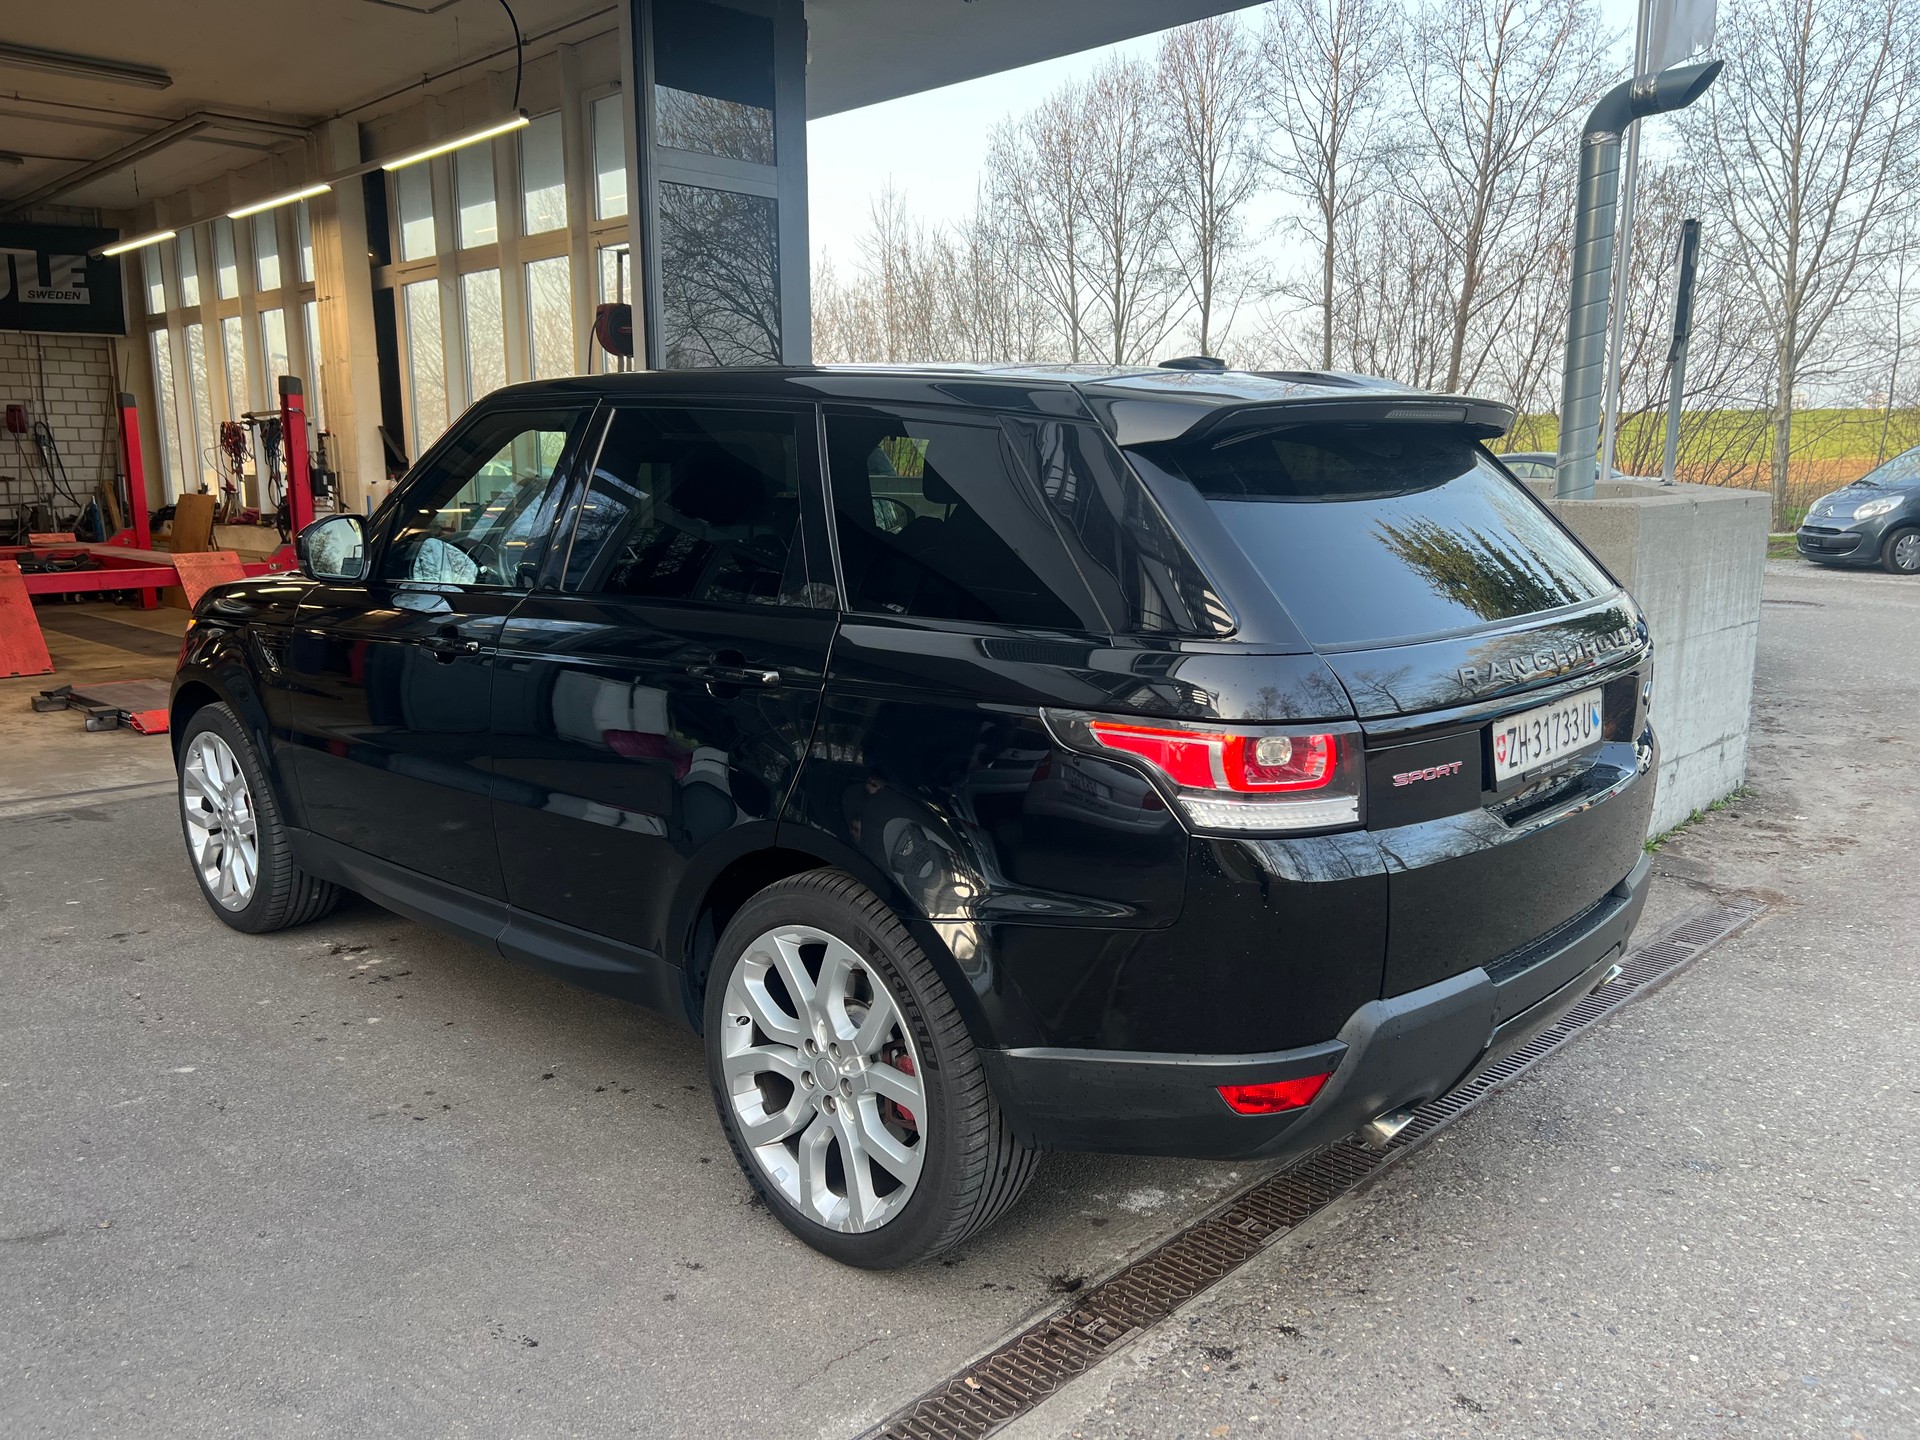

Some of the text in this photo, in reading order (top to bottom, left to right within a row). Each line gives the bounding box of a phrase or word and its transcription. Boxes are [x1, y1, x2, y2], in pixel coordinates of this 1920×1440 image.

[0, 247, 90, 305] LE
[27, 290, 81, 300] SWEDEN
[1392, 761, 1463, 787] SPORT
[872, 947, 938, 1065] MICHELIN
